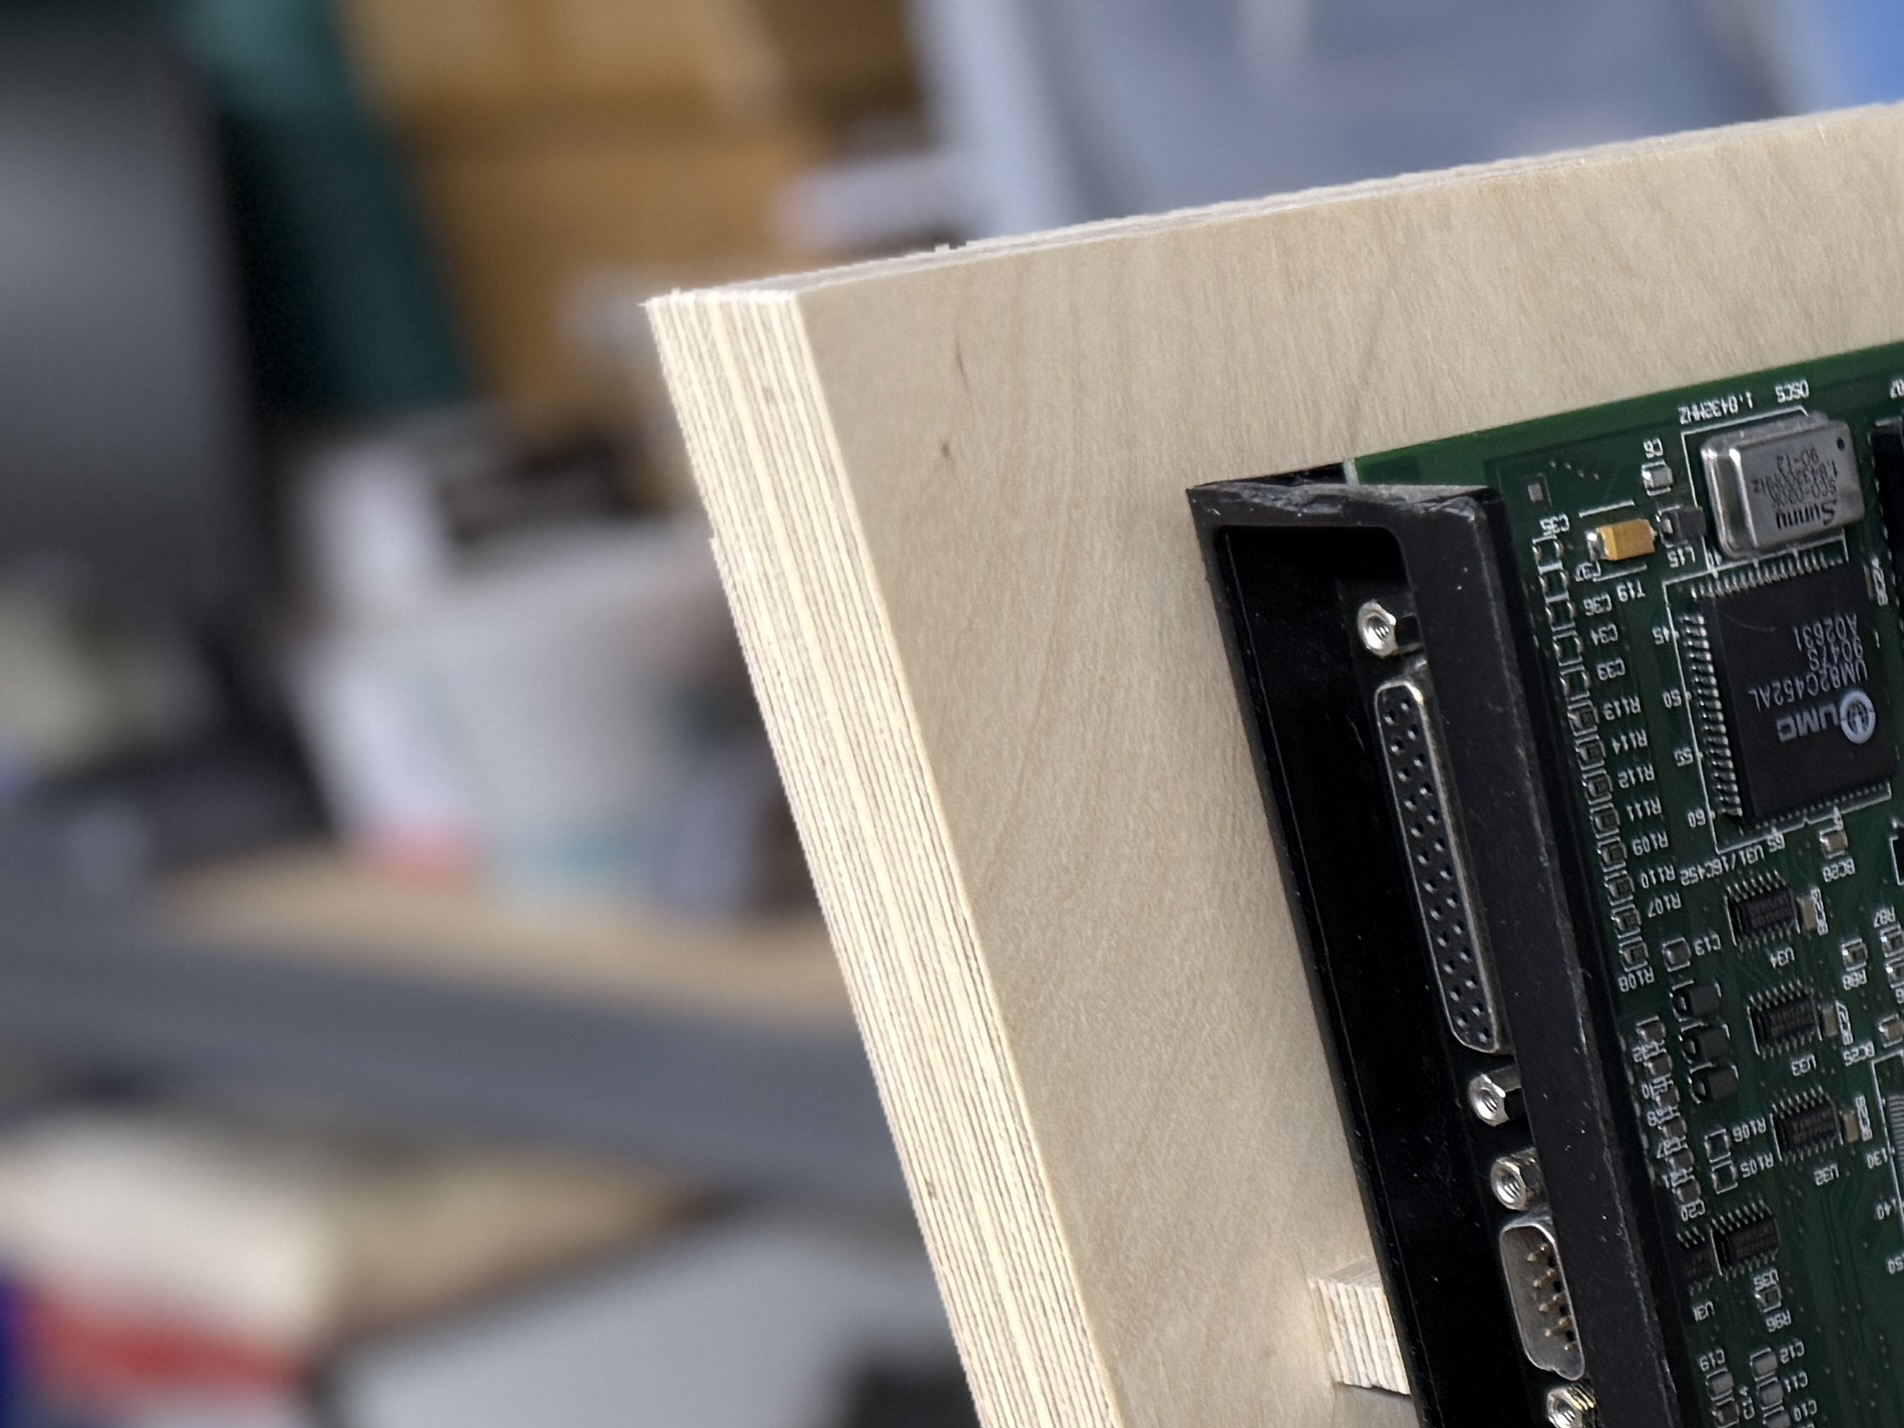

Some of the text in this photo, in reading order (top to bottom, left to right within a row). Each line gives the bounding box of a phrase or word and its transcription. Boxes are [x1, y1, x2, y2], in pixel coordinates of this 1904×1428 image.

[1539, 511, 1570, 535] C35
[1776, 498, 1837, 530] Sunny
[1666, 546, 1695, 567] L15
[1616, 581, 1646, 602] T19
[1583, 592, 1611, 617] C36
[1591, 623, 1618, 644] C34
[1596, 658, 1625, 679] C33
[1748, 660, 1868, 711] UM82C452AL
[1602, 693, 1642, 721] R113
[1776, 703, 1841, 744] UMC
[1610, 727, 1648, 753] R114
[1616, 763, 1655, 789] R112
[1625, 797, 1663, 823] R111
[1632, 831, 1670, 857] R109
[1641, 864, 1676, 889] R110
[1679, 844, 1765, 887] U31/16C452
[1647, 892, 1682, 917] R107
[1693, 933, 1722, 957] C13
[1769, 947, 1795, 968] U34
[1616, 966, 1655, 991] R108
[1790, 1054, 1817, 1077] U33
[1732, 1118, 1767, 1142] R106
[1739, 1153, 1775, 1178] R105
[1813, 1163, 1840, 1186] U32
[1753, 1268, 1780, 1289] U35
[1765, 1310, 1792, 1332] R96
[1698, 1348, 1726, 1371] C19
[1779, 1341, 1805, 1363] C12
[1784, 1371, 1809, 1393] C11
[1792, 1400, 1819, 1421] C10
